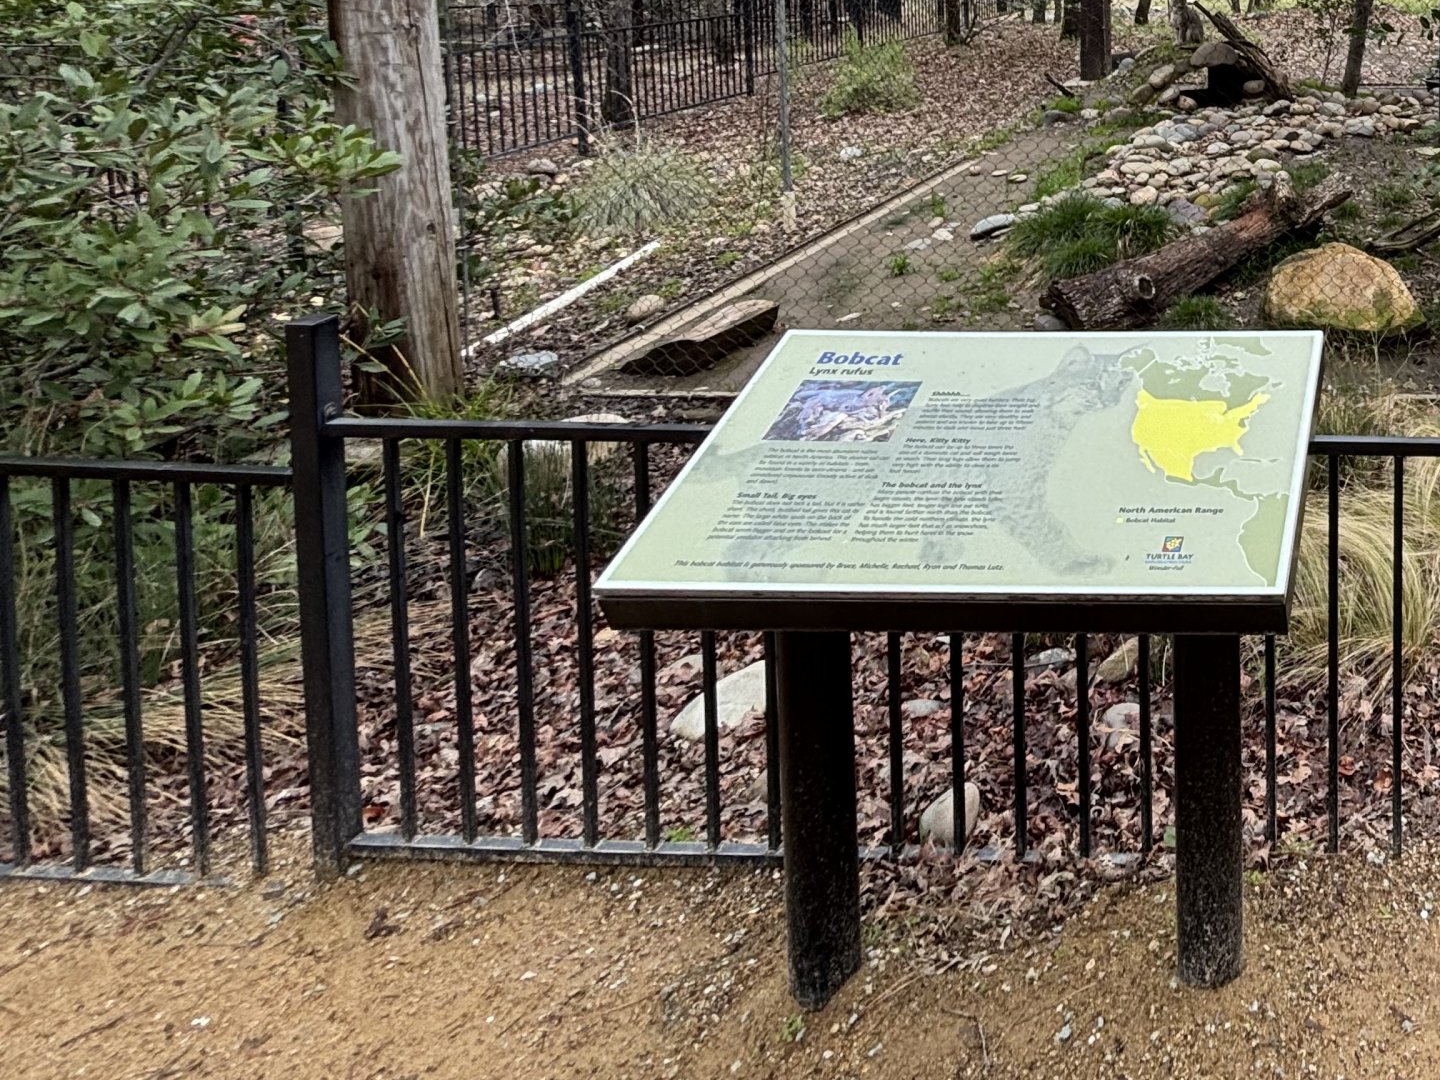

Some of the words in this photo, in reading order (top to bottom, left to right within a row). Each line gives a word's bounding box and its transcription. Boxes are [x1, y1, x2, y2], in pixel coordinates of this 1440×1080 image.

[816, 352, 904, 366] Bobcat
[809, 367, 839, 377] Lynx
[840, 368, 873, 376] rufus
[781, 493, 796, 501] Big
[1195, 507, 1224, 515] Range
